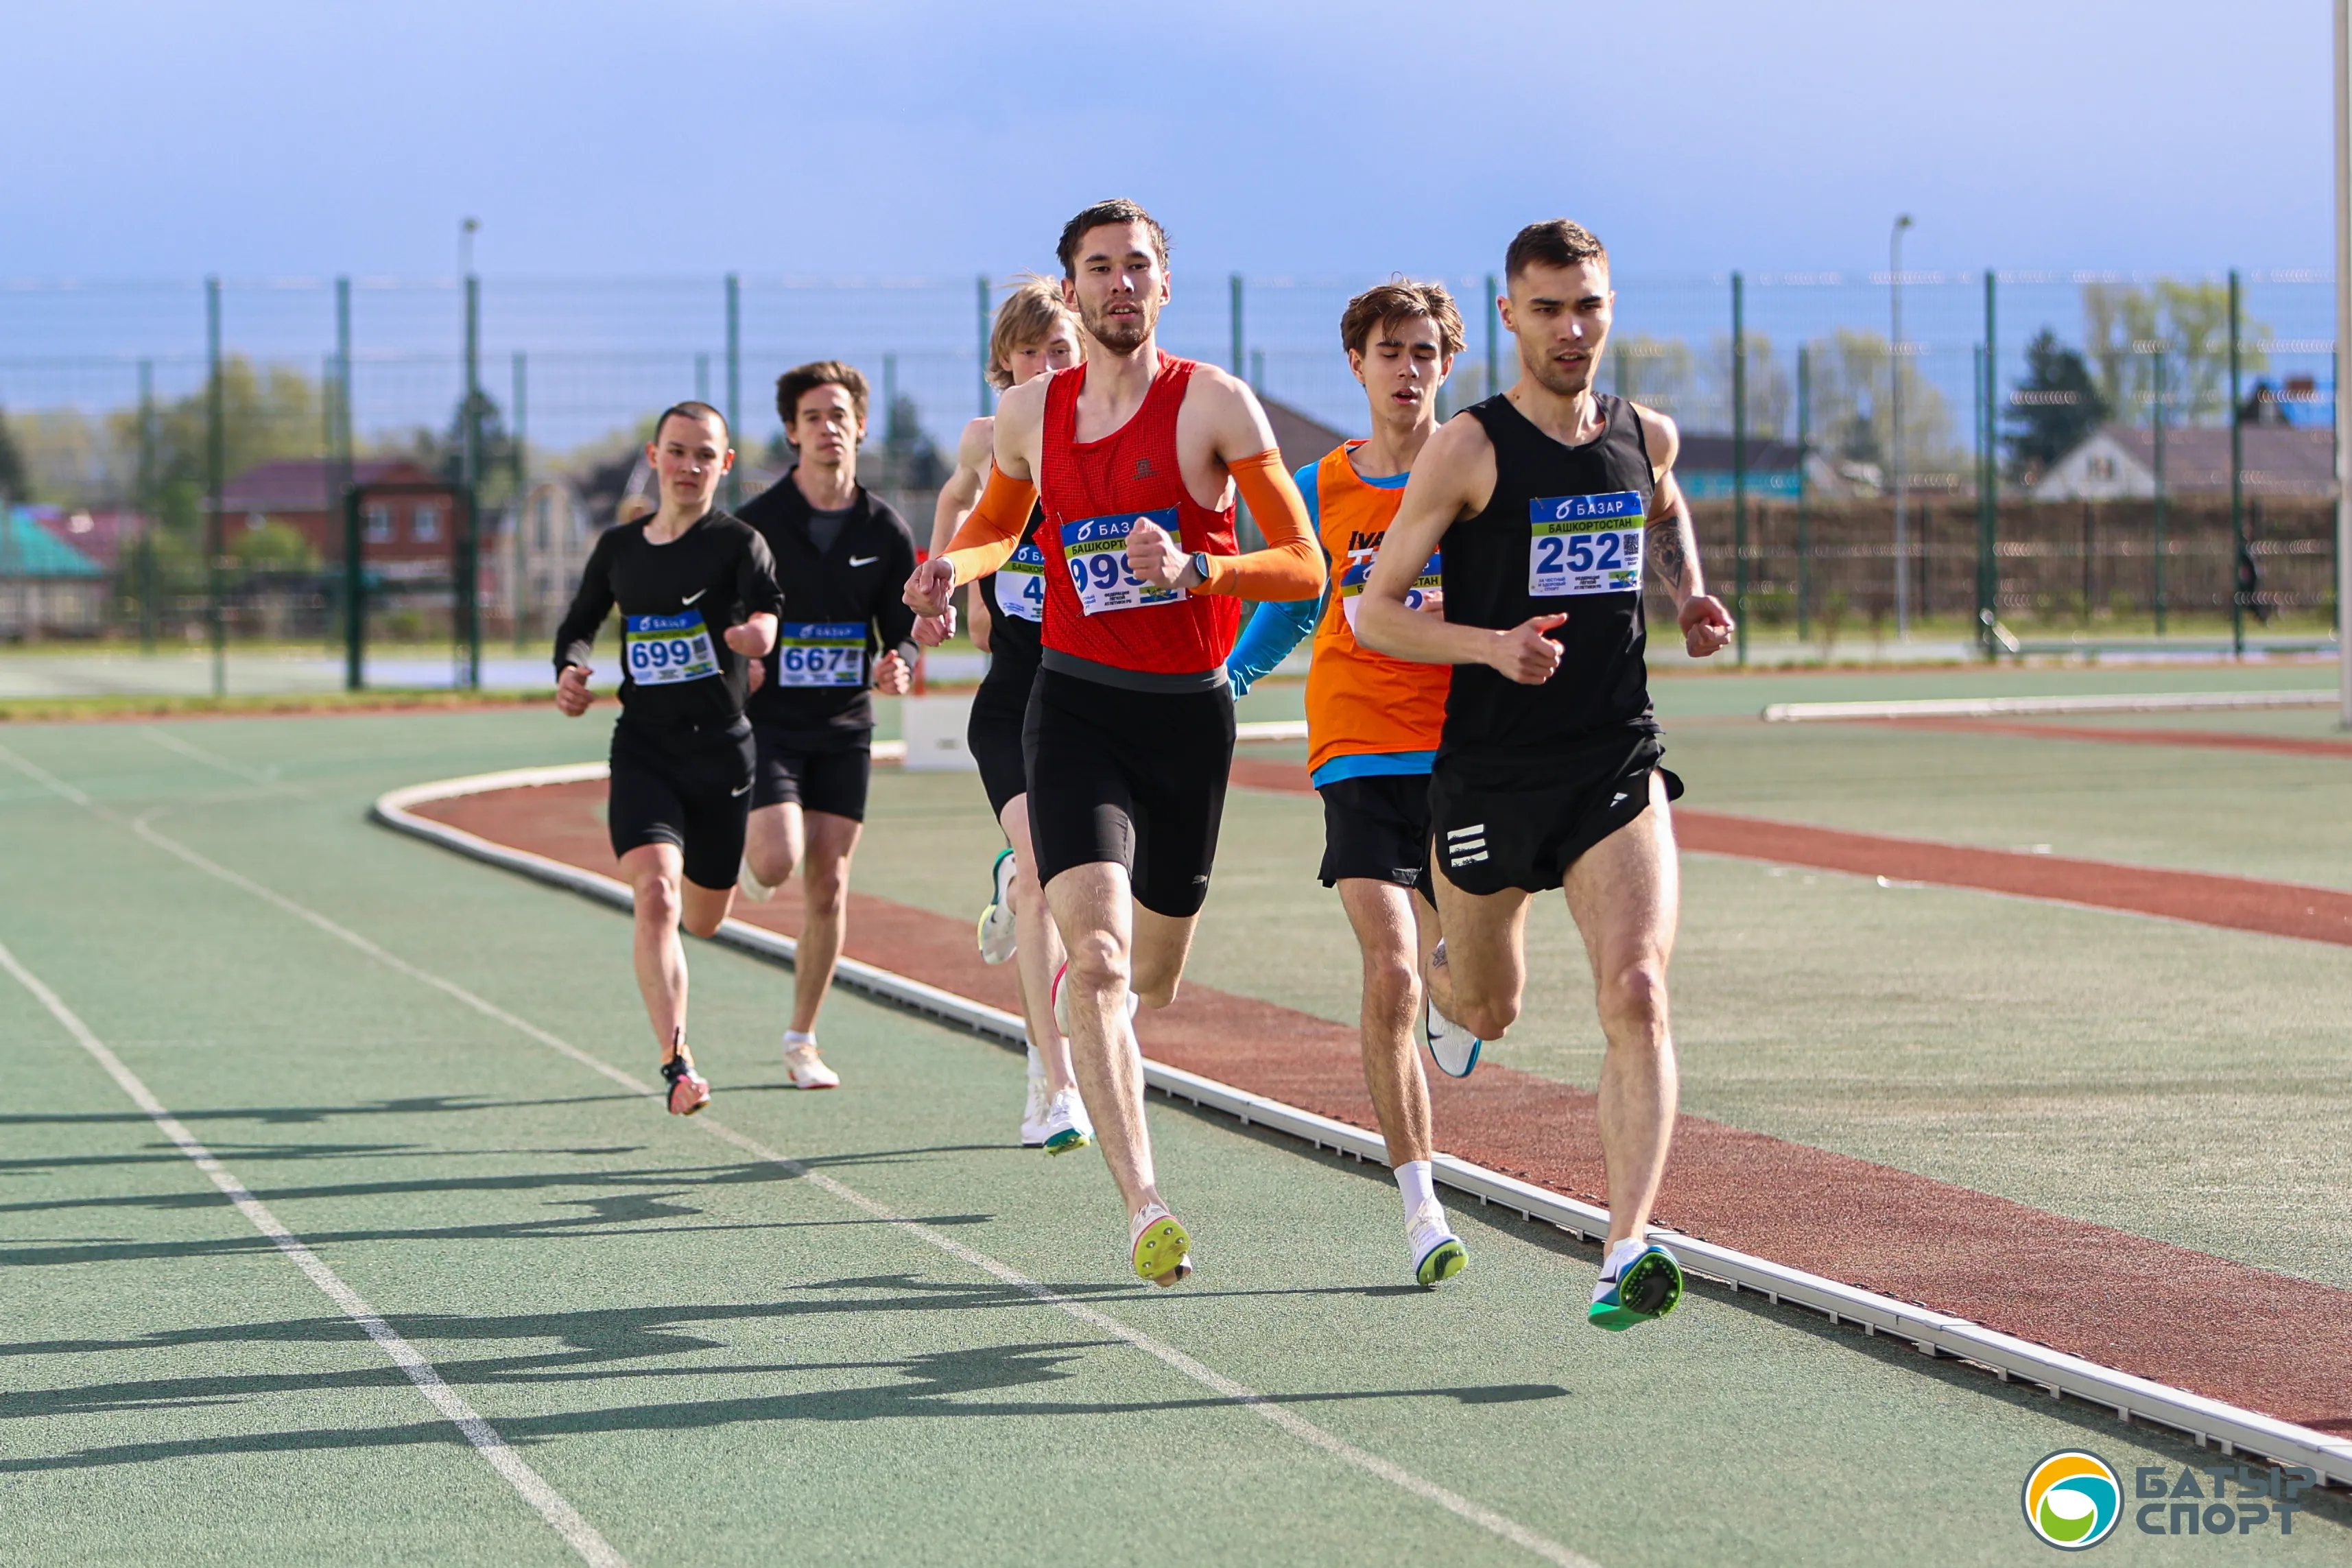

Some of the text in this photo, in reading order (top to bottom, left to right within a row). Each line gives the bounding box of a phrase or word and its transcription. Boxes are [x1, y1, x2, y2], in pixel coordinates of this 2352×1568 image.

[1577, 501, 1623, 515] БАЗАР
[1099, 522, 1130, 536] БАЗ
[1549, 518, 1632, 534] БАШКОРТОСТАН
[1071, 540, 1128, 555] БАШКОРТ
[1536, 533, 1622, 574] 252
[632, 639, 691, 668] 699
[785, 648, 844, 671] 667
